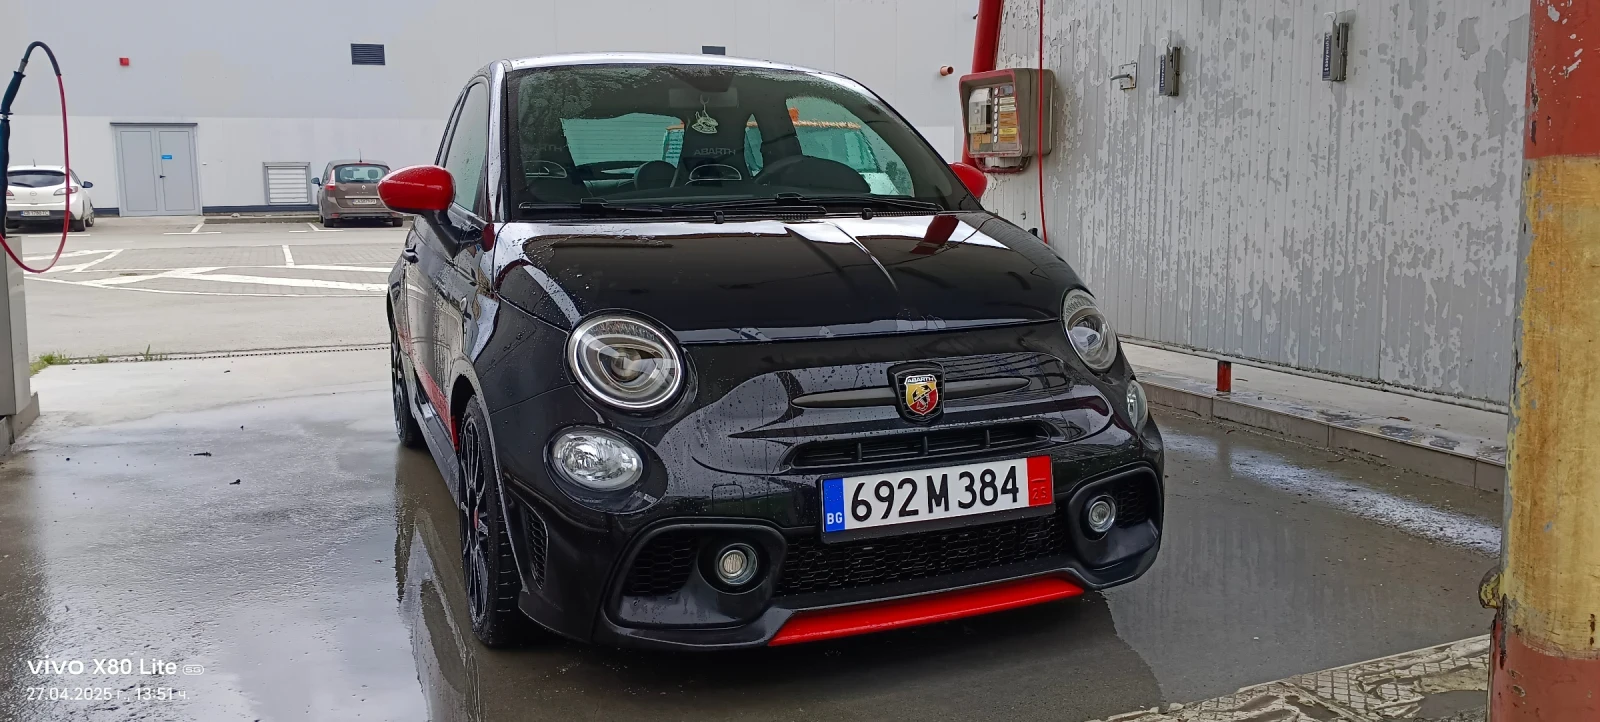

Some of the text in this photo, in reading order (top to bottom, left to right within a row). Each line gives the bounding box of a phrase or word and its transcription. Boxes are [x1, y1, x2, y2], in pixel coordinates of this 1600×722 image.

[693, 147, 736, 156] ABARTH
[851, 465, 1019, 522] 692 M 384
[826, 512, 843, 525] BG
